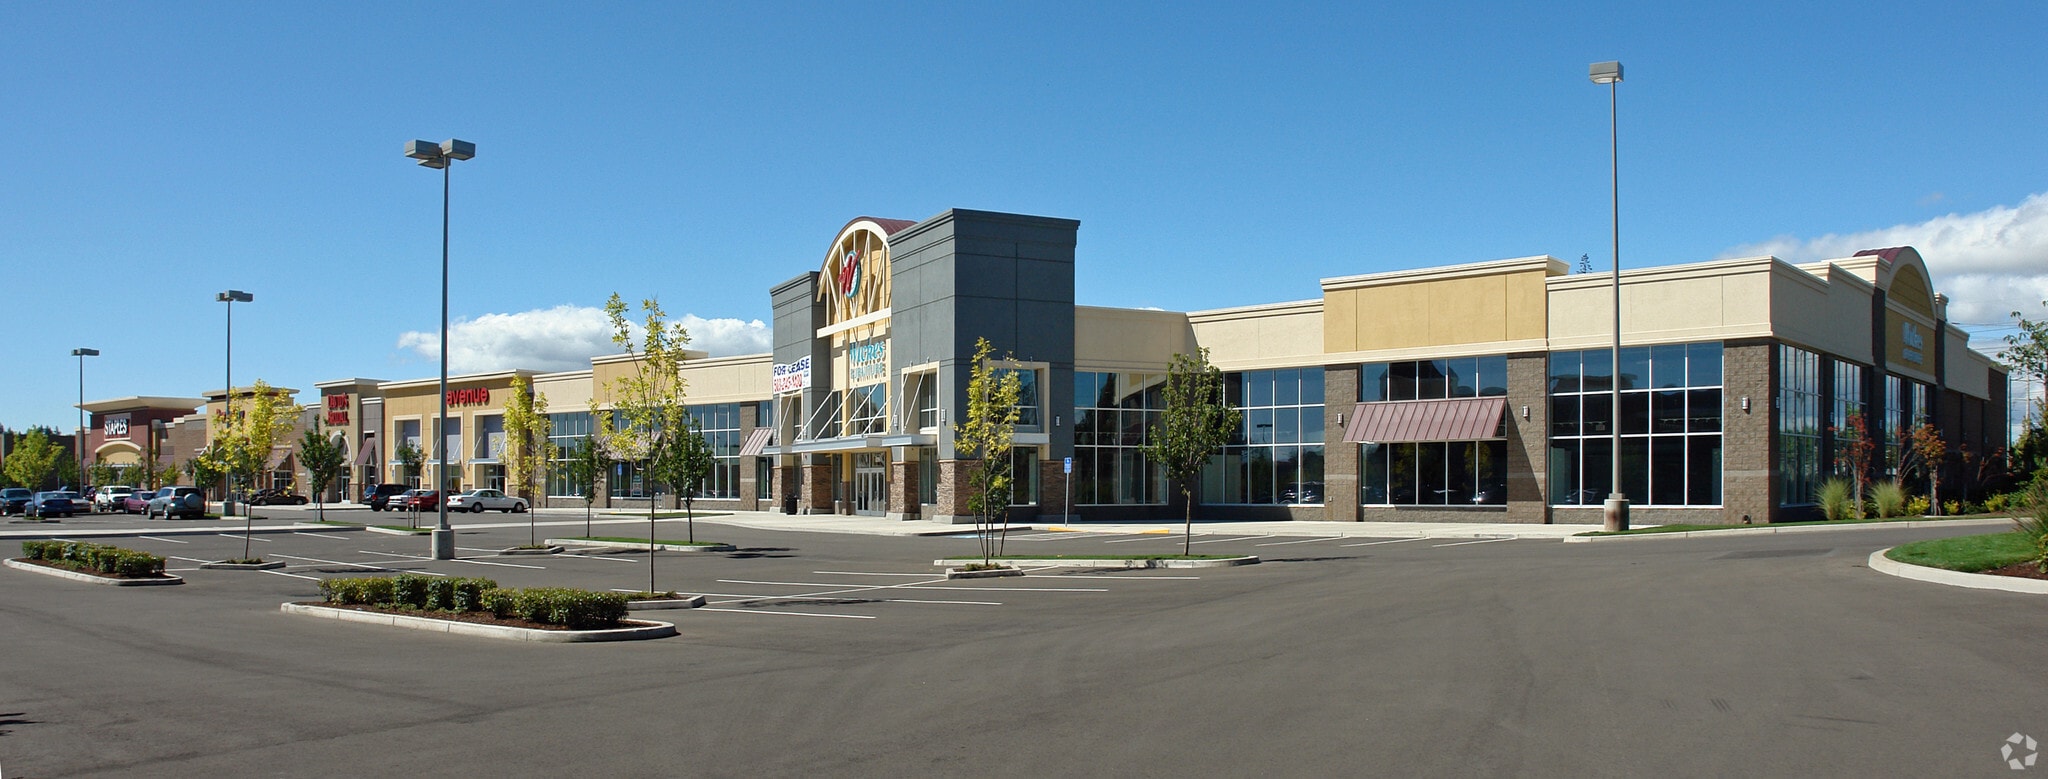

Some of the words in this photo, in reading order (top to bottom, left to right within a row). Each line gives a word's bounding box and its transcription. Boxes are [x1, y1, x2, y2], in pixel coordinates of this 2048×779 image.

[773, 365, 786, 377] FOR
[787, 358, 810, 374] LEASE
[446, 387, 490, 405] avenue
[104, 419, 129, 435] STAPLES
